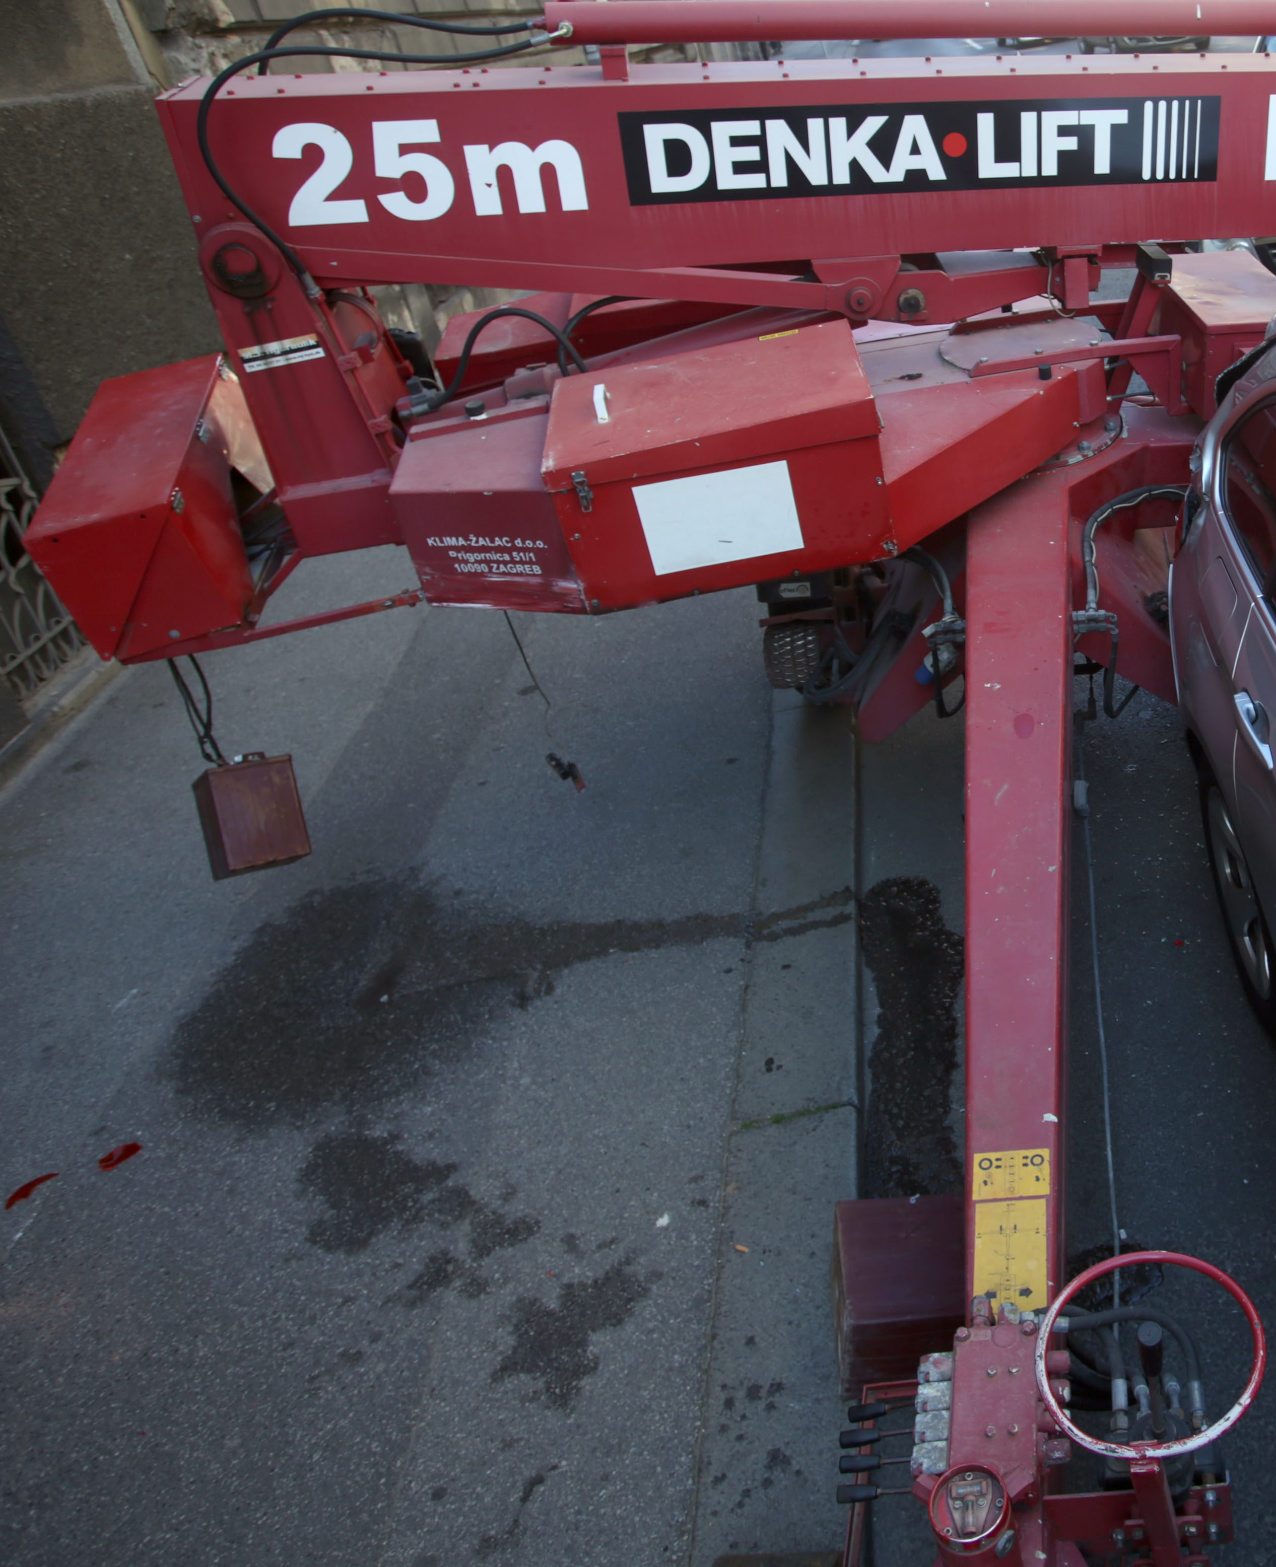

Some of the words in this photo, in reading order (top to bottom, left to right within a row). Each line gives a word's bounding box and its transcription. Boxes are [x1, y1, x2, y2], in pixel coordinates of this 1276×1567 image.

[642, 114, 947, 194] DENKA
[976, 109, 1129, 179] LIFT
[272, 119, 589, 227] 25m
[426, 534, 512, 547] KLIMA-ŽALAC
[514, 538, 548, 549] d.o.o.
[512, 551, 536, 562] 51/1
[490, 563, 542, 575] ZAGREB
